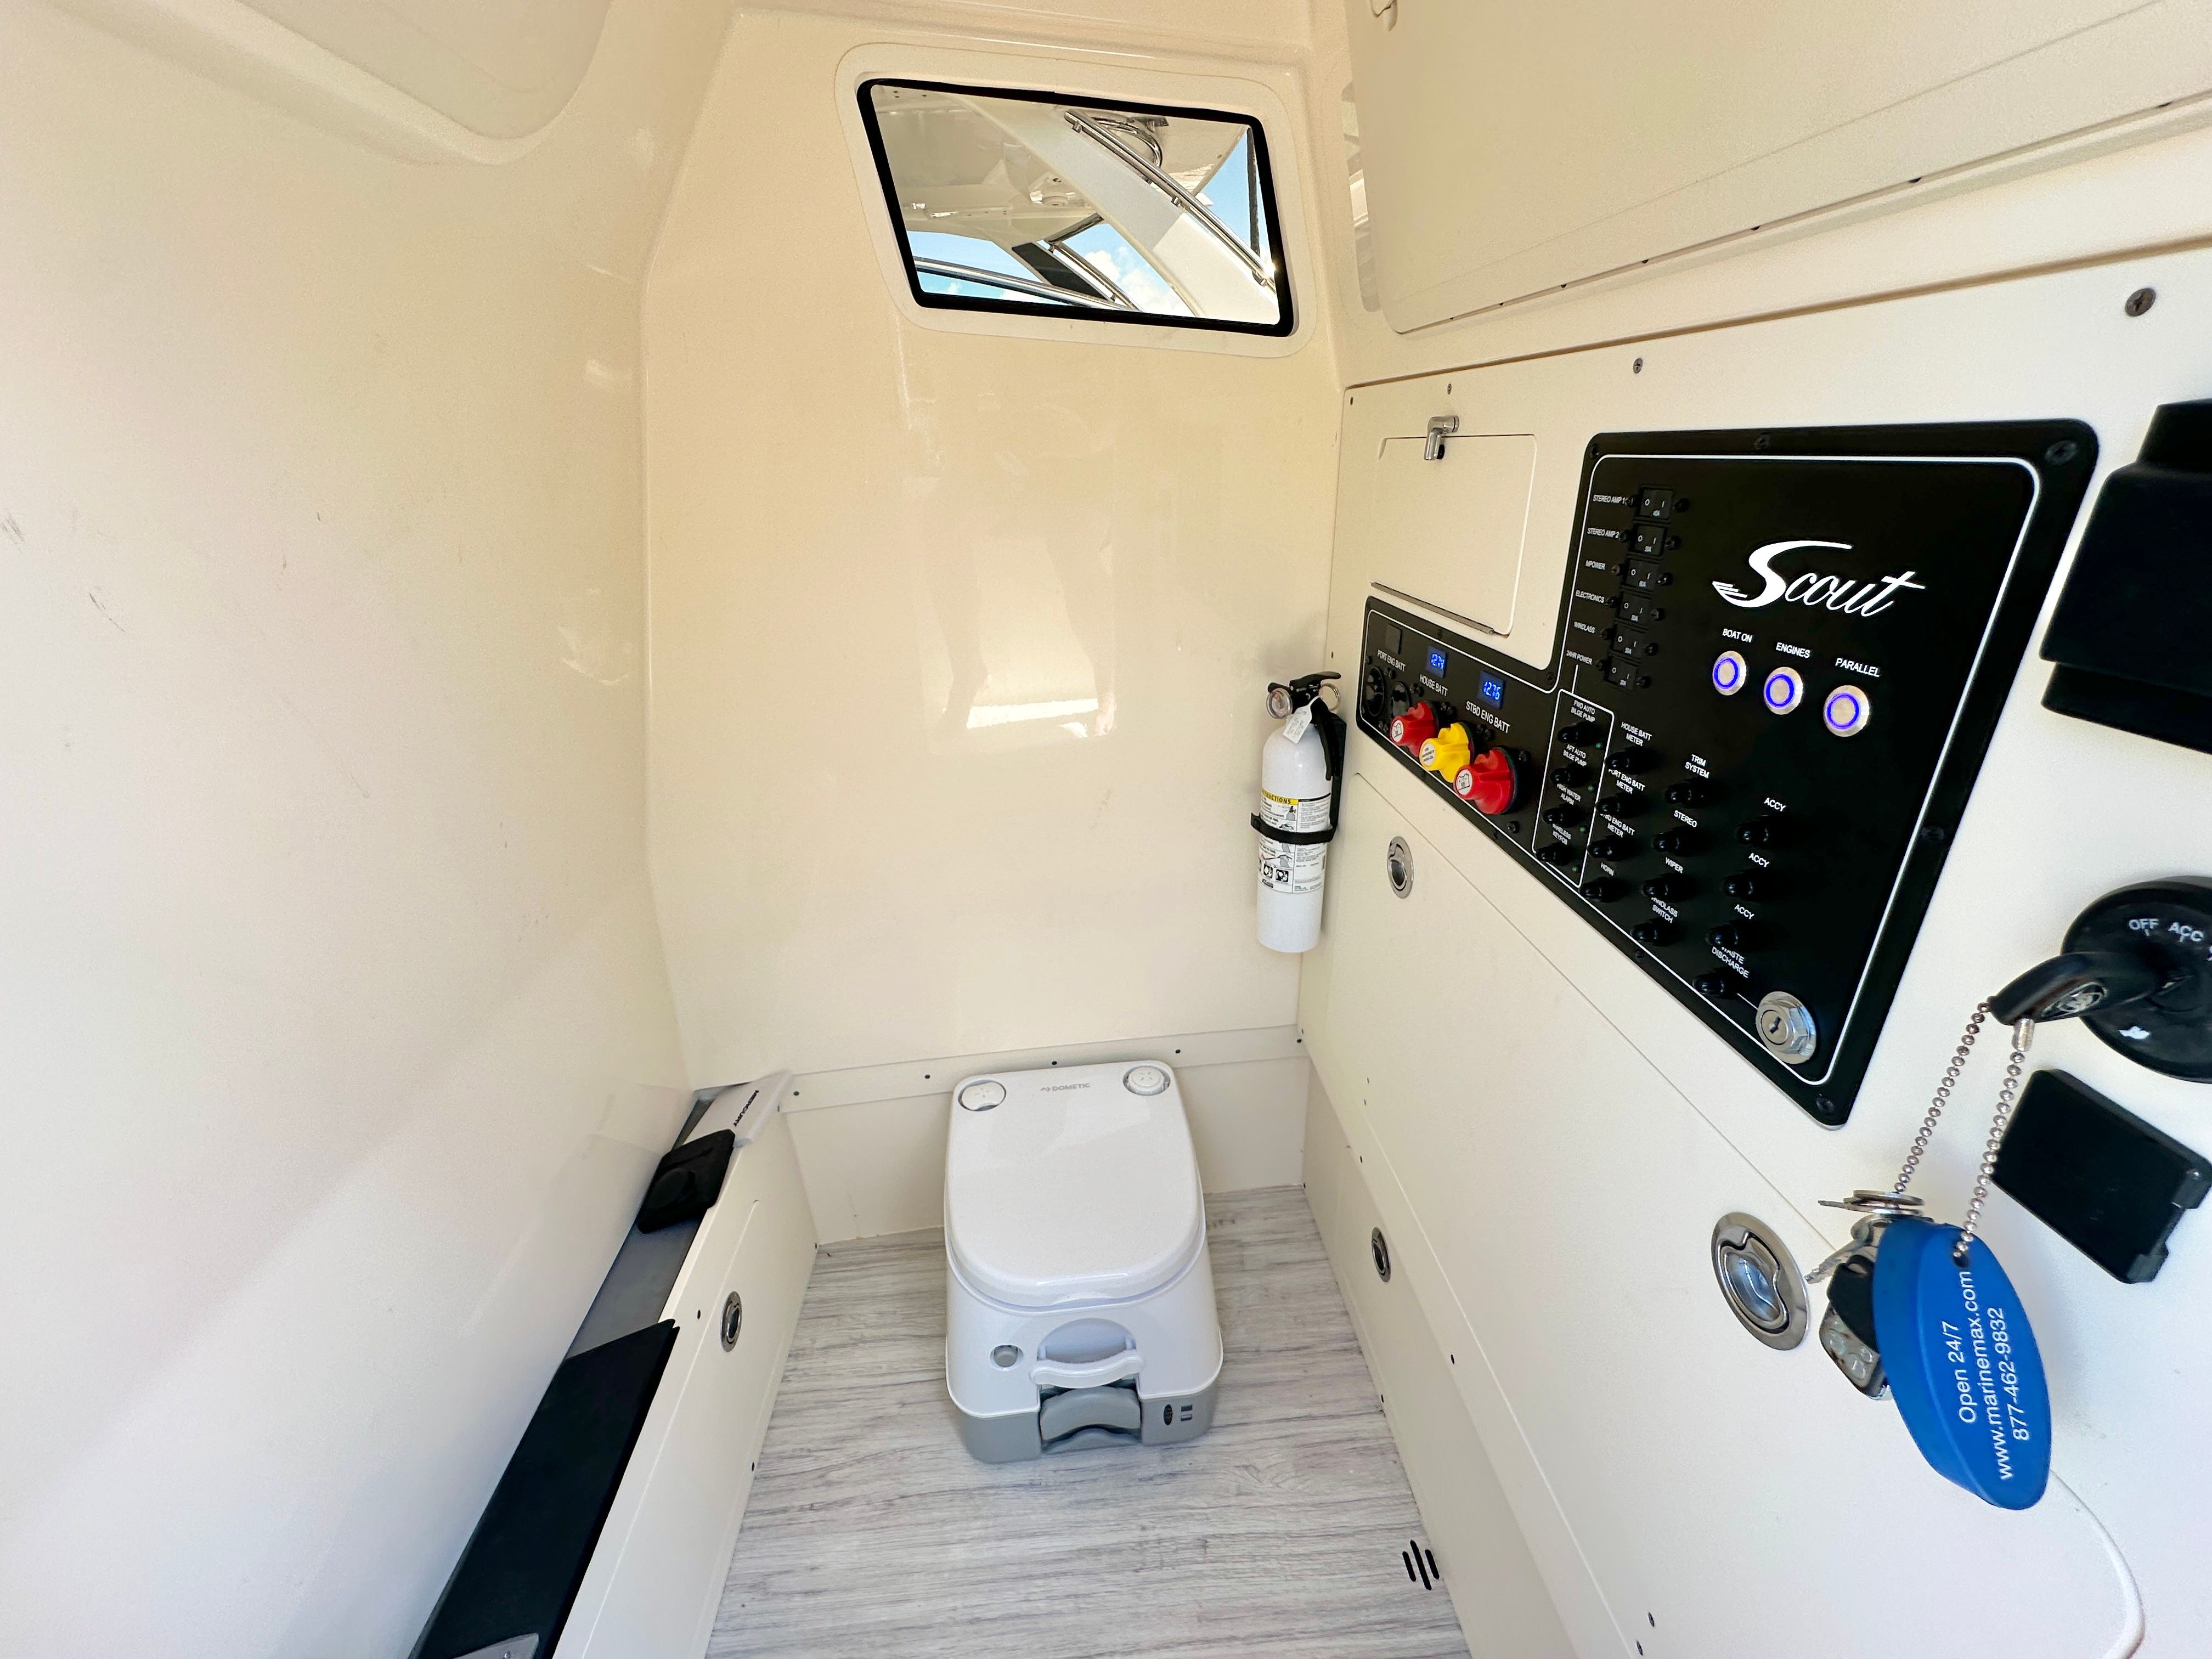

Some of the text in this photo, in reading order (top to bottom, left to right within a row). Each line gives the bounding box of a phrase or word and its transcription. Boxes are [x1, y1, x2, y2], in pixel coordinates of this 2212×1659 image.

[1593, 494, 1611, 503] STEREO
[1611, 496, 1622, 504] AMP
[1587, 527, 1606, 536] STEREO
[1712, 540, 1925, 617] Scout
[1575, 590, 1605, 603] ELECTRONICS
[1574, 621, 1595, 634] WINDLASS
[1722, 628, 1753, 644] BOAT ON
[1775, 642, 1810, 658] ENGINES
[1377, 649, 1406, 672] PORT ENG BATT
[1576, 653, 1593, 665] POWER
[1835, 658, 1880, 678] PARALLEL
[1419, 674, 1448, 697] HOUSE BATT
[1466, 701, 1510, 733] STBD ENG BATT
[1571, 707, 1595, 723] BILGE PUMP
[1583, 704, 1595, 714] AUTO
[1621, 721, 1652, 741] HOUSE BATT
[1626, 733, 1644, 747] METER
[1563, 749, 1587, 766] BILGE PUMP
[1566, 744, 1586, 759] AFT AUTO
[1691, 754, 1706, 767] TRIM
[1685, 761, 1709, 779] SYSTEM
[1616, 780, 1633, 794] METER
[1621, 774, 1632, 784] ENG
[1632, 780, 1645, 791] BATT
[1560, 793, 1575, 805] ALARM
[1567, 788, 1581, 802] WATER
[1763, 797, 1787, 812] ACCY
[1611, 817, 1622, 828] ENG
[1622, 823, 1635, 836] BATT
[1674, 810, 1698, 827] STEREO
[1552, 823, 1571, 840] WIRELESS
[1552, 830, 1568, 845] KEYFOB
[1607, 823, 1623, 838] METER
[1665, 857, 1684, 874] WIPER
[1748, 853, 1770, 868] ACCY
[1600, 862, 1615, 876] HORN
[1652, 904, 1673, 923] SWITCH
[1734, 904, 1754, 920] ACCY
[2128, 918, 2204, 941] OFF ACC
[1711, 946, 1750, 978] DISCHARGE
[1942, 1321, 1978, 1424] Open 24/7
[1959, 1269, 2014, 1481] www.marinemax.com
[1987, 1307, 2030, 1441] 877-462-9832
